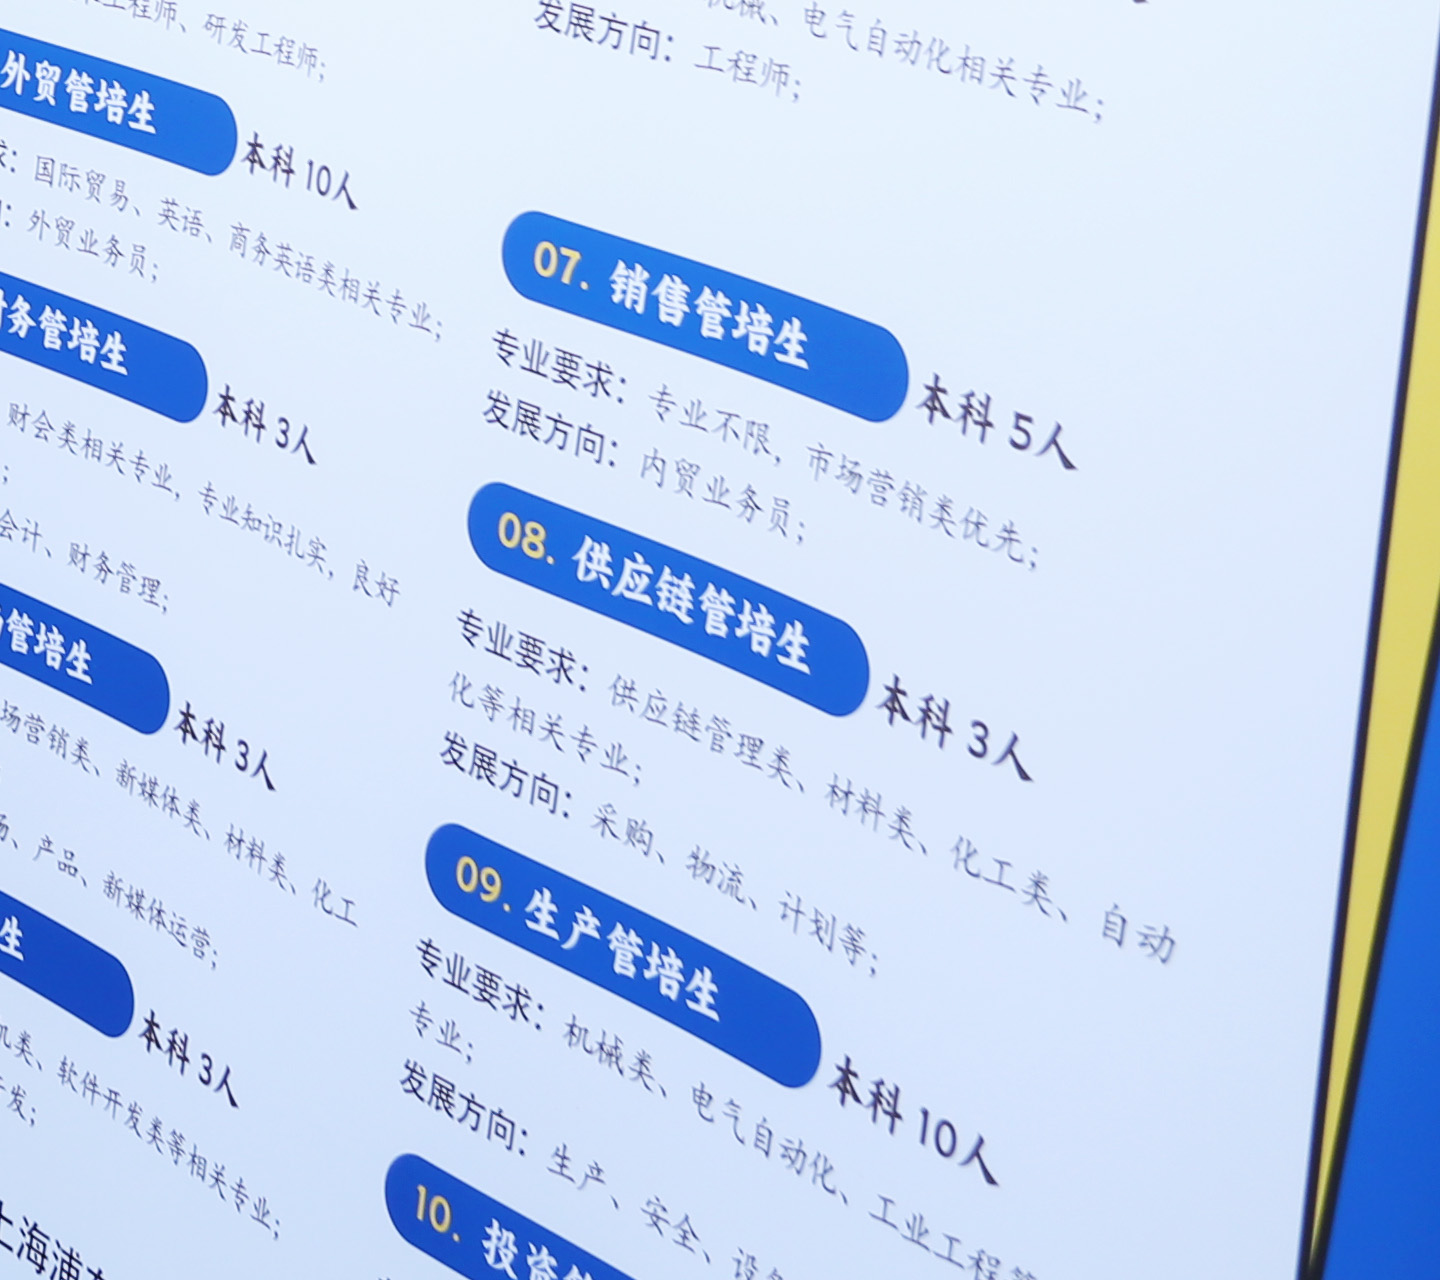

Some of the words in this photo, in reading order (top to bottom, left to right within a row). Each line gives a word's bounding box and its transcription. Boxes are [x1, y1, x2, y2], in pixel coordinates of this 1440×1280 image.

[0, 49, 158, 135] 外贸管培生
[608, 258, 810, 371] 销售管培生
[571, 534, 812, 677] 供应链管培生
[522, 886, 722, 1025] 生产管培生
[398, 1058, 786, 1280] 发展方向：生产、安全、设
[480, 1217, 595, 1280] 投资
